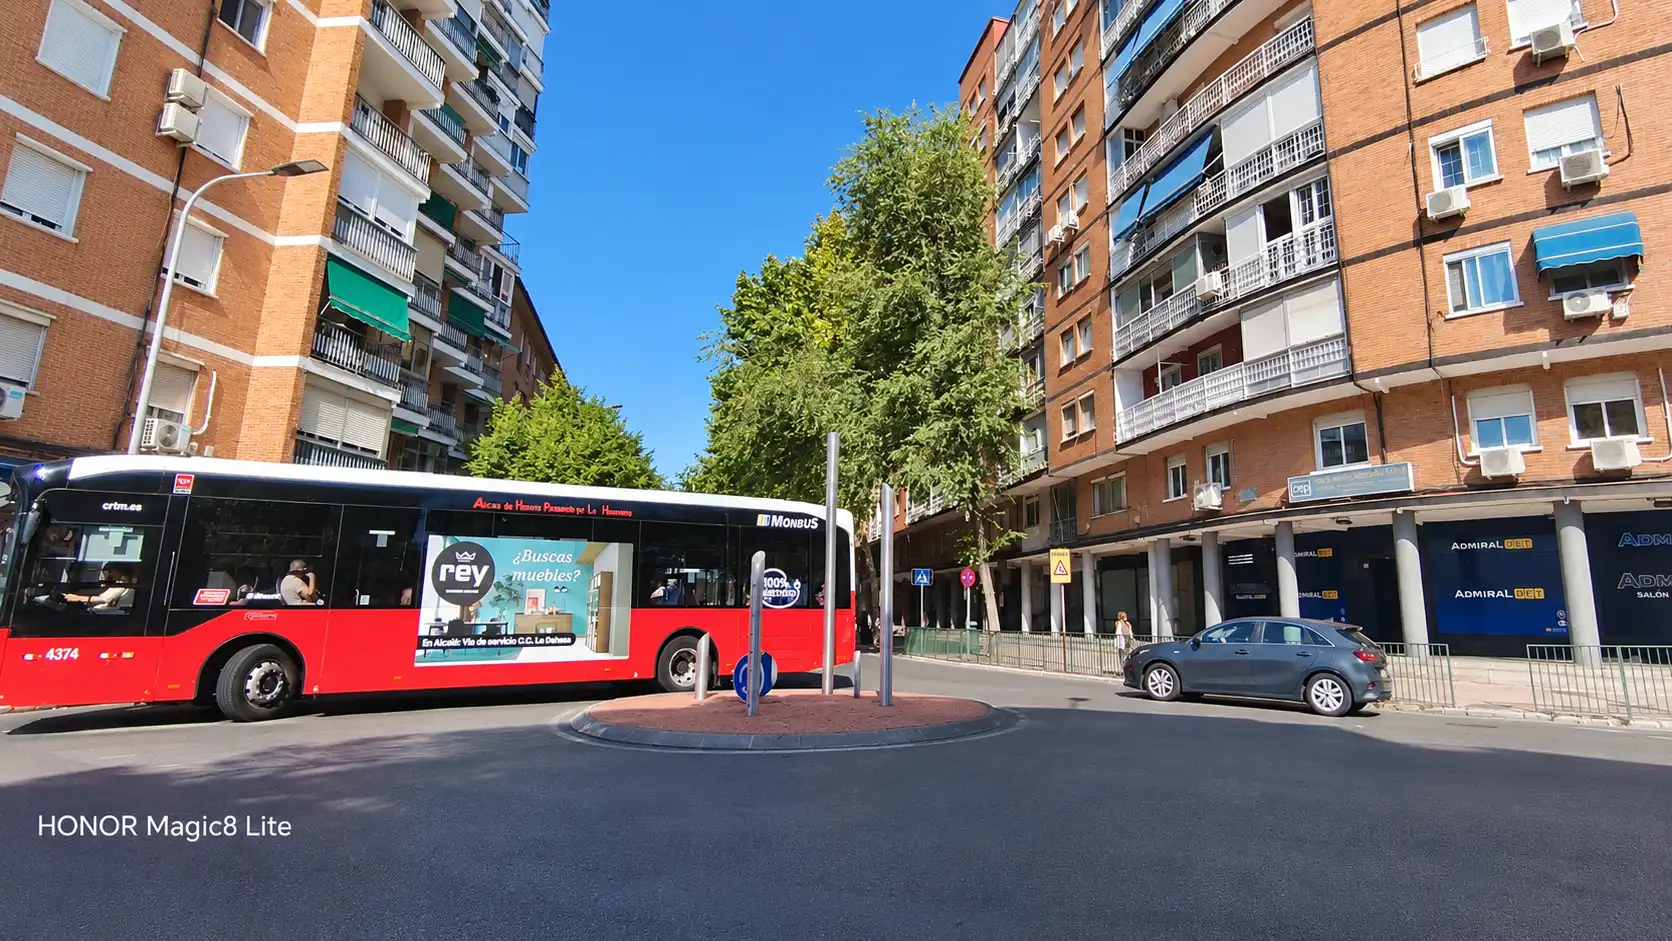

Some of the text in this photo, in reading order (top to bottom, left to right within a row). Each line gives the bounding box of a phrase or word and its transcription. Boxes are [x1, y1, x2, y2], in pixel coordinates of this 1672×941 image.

[102, 502, 142, 512] crtm.es
[770, 515, 819, 529] MONBUS
[512, 549, 573, 565] ¿Buscas
[439, 564, 490, 588] rey
[511, 569, 582, 583] muebles?
[1637, 588, 1670, 599] SALÓN
[45, 648, 79, 660] 4374
